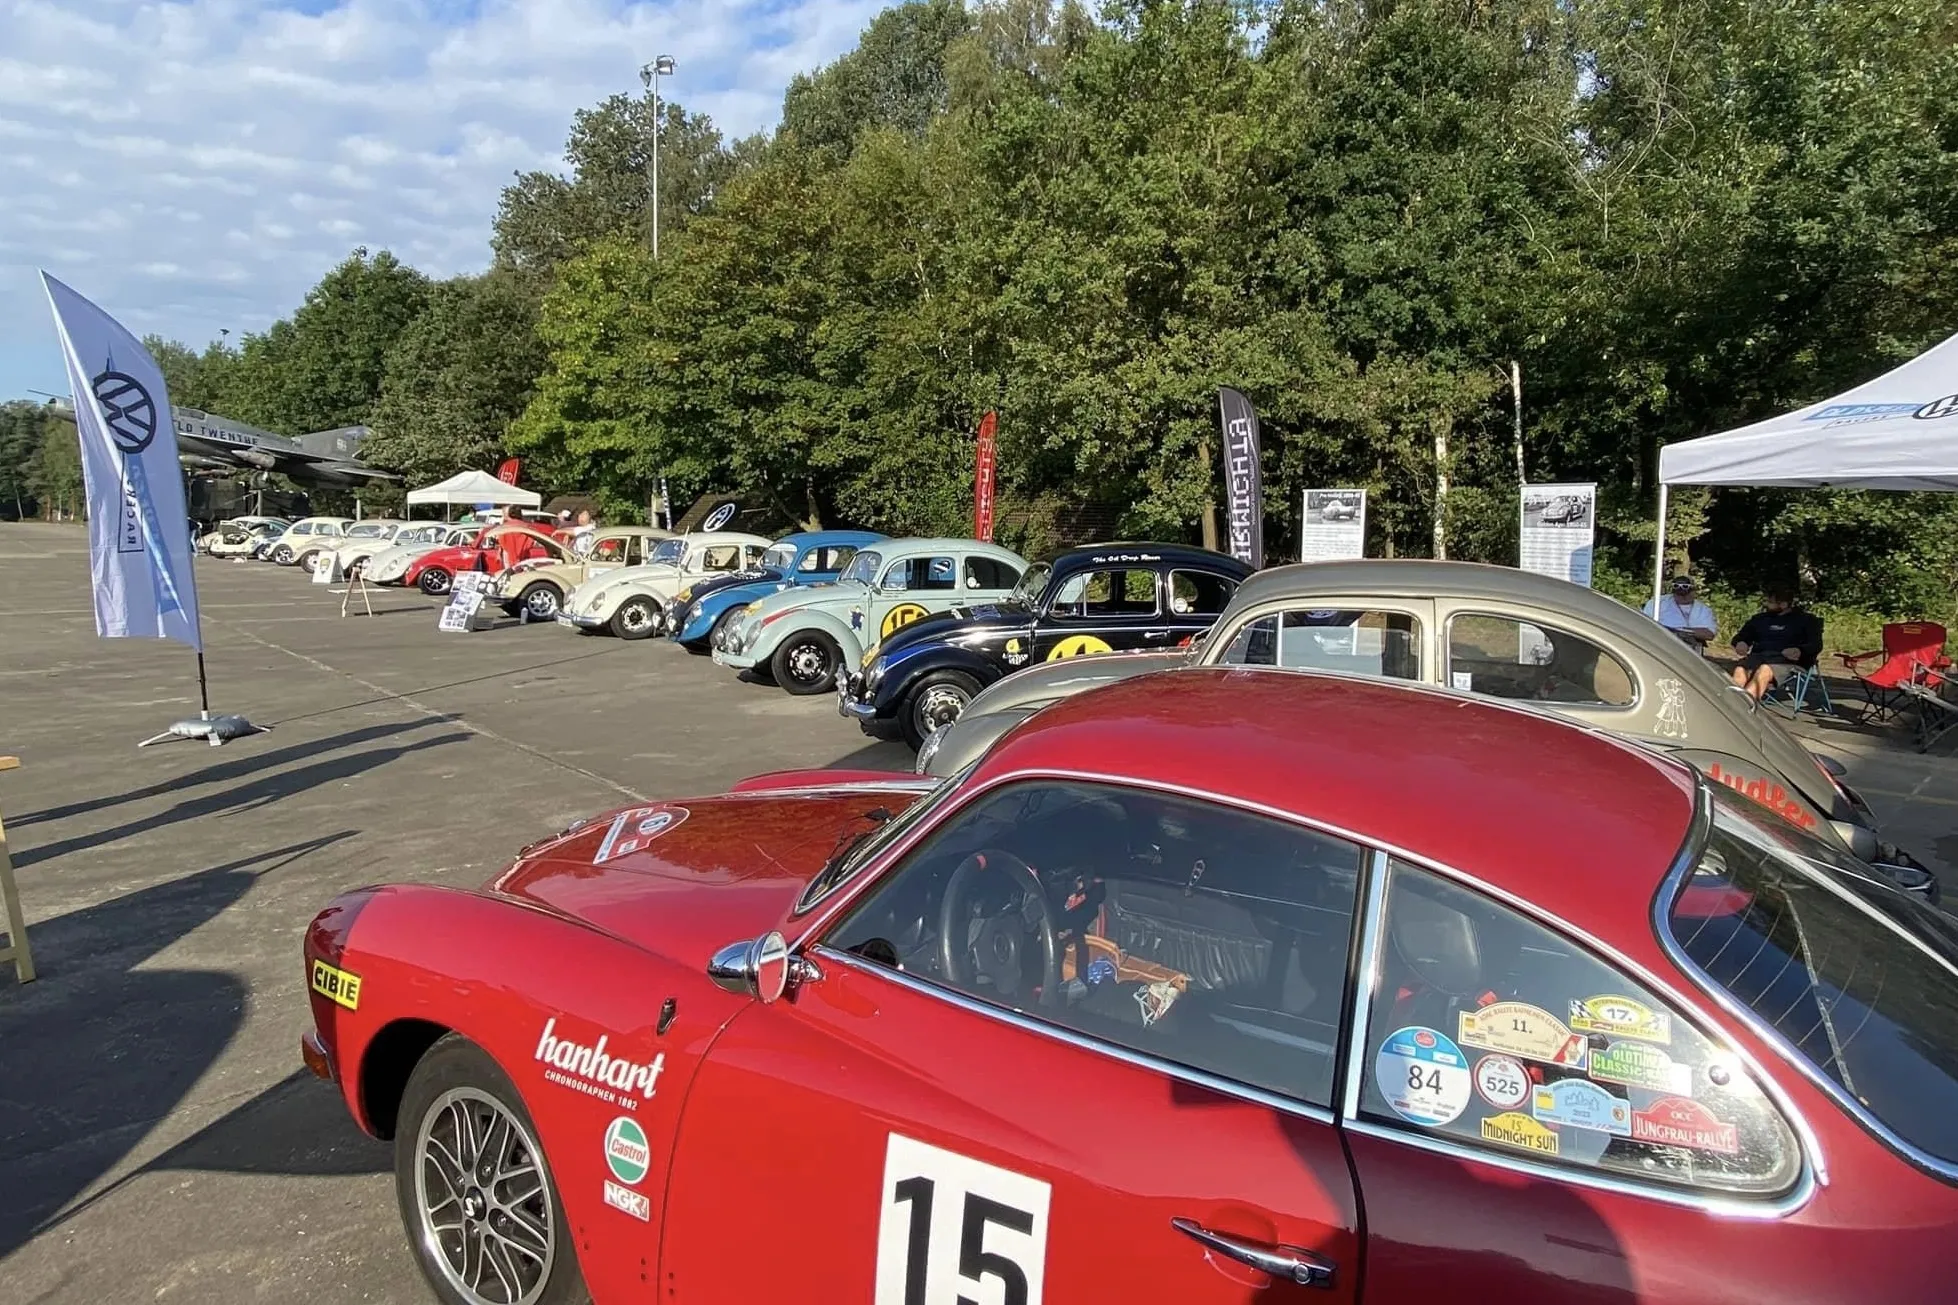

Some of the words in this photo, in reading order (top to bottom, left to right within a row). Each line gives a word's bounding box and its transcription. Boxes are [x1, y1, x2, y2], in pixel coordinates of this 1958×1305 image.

[535, 1017, 665, 1099] hanhart
[544, 1069, 616, 1103] CHRONOGRAPHEN
[1408, 1065, 1443, 1095] 84
[1486, 1077, 1520, 1096] 525
[611, 1138, 647, 1164] Castrol
[1483, 1120, 1534, 1147] MIDNIGHT
[1536, 1135, 1557, 1152] SUN
[607, 1182, 643, 1217] NGK
[894, 1176, 1034, 1305] 15
